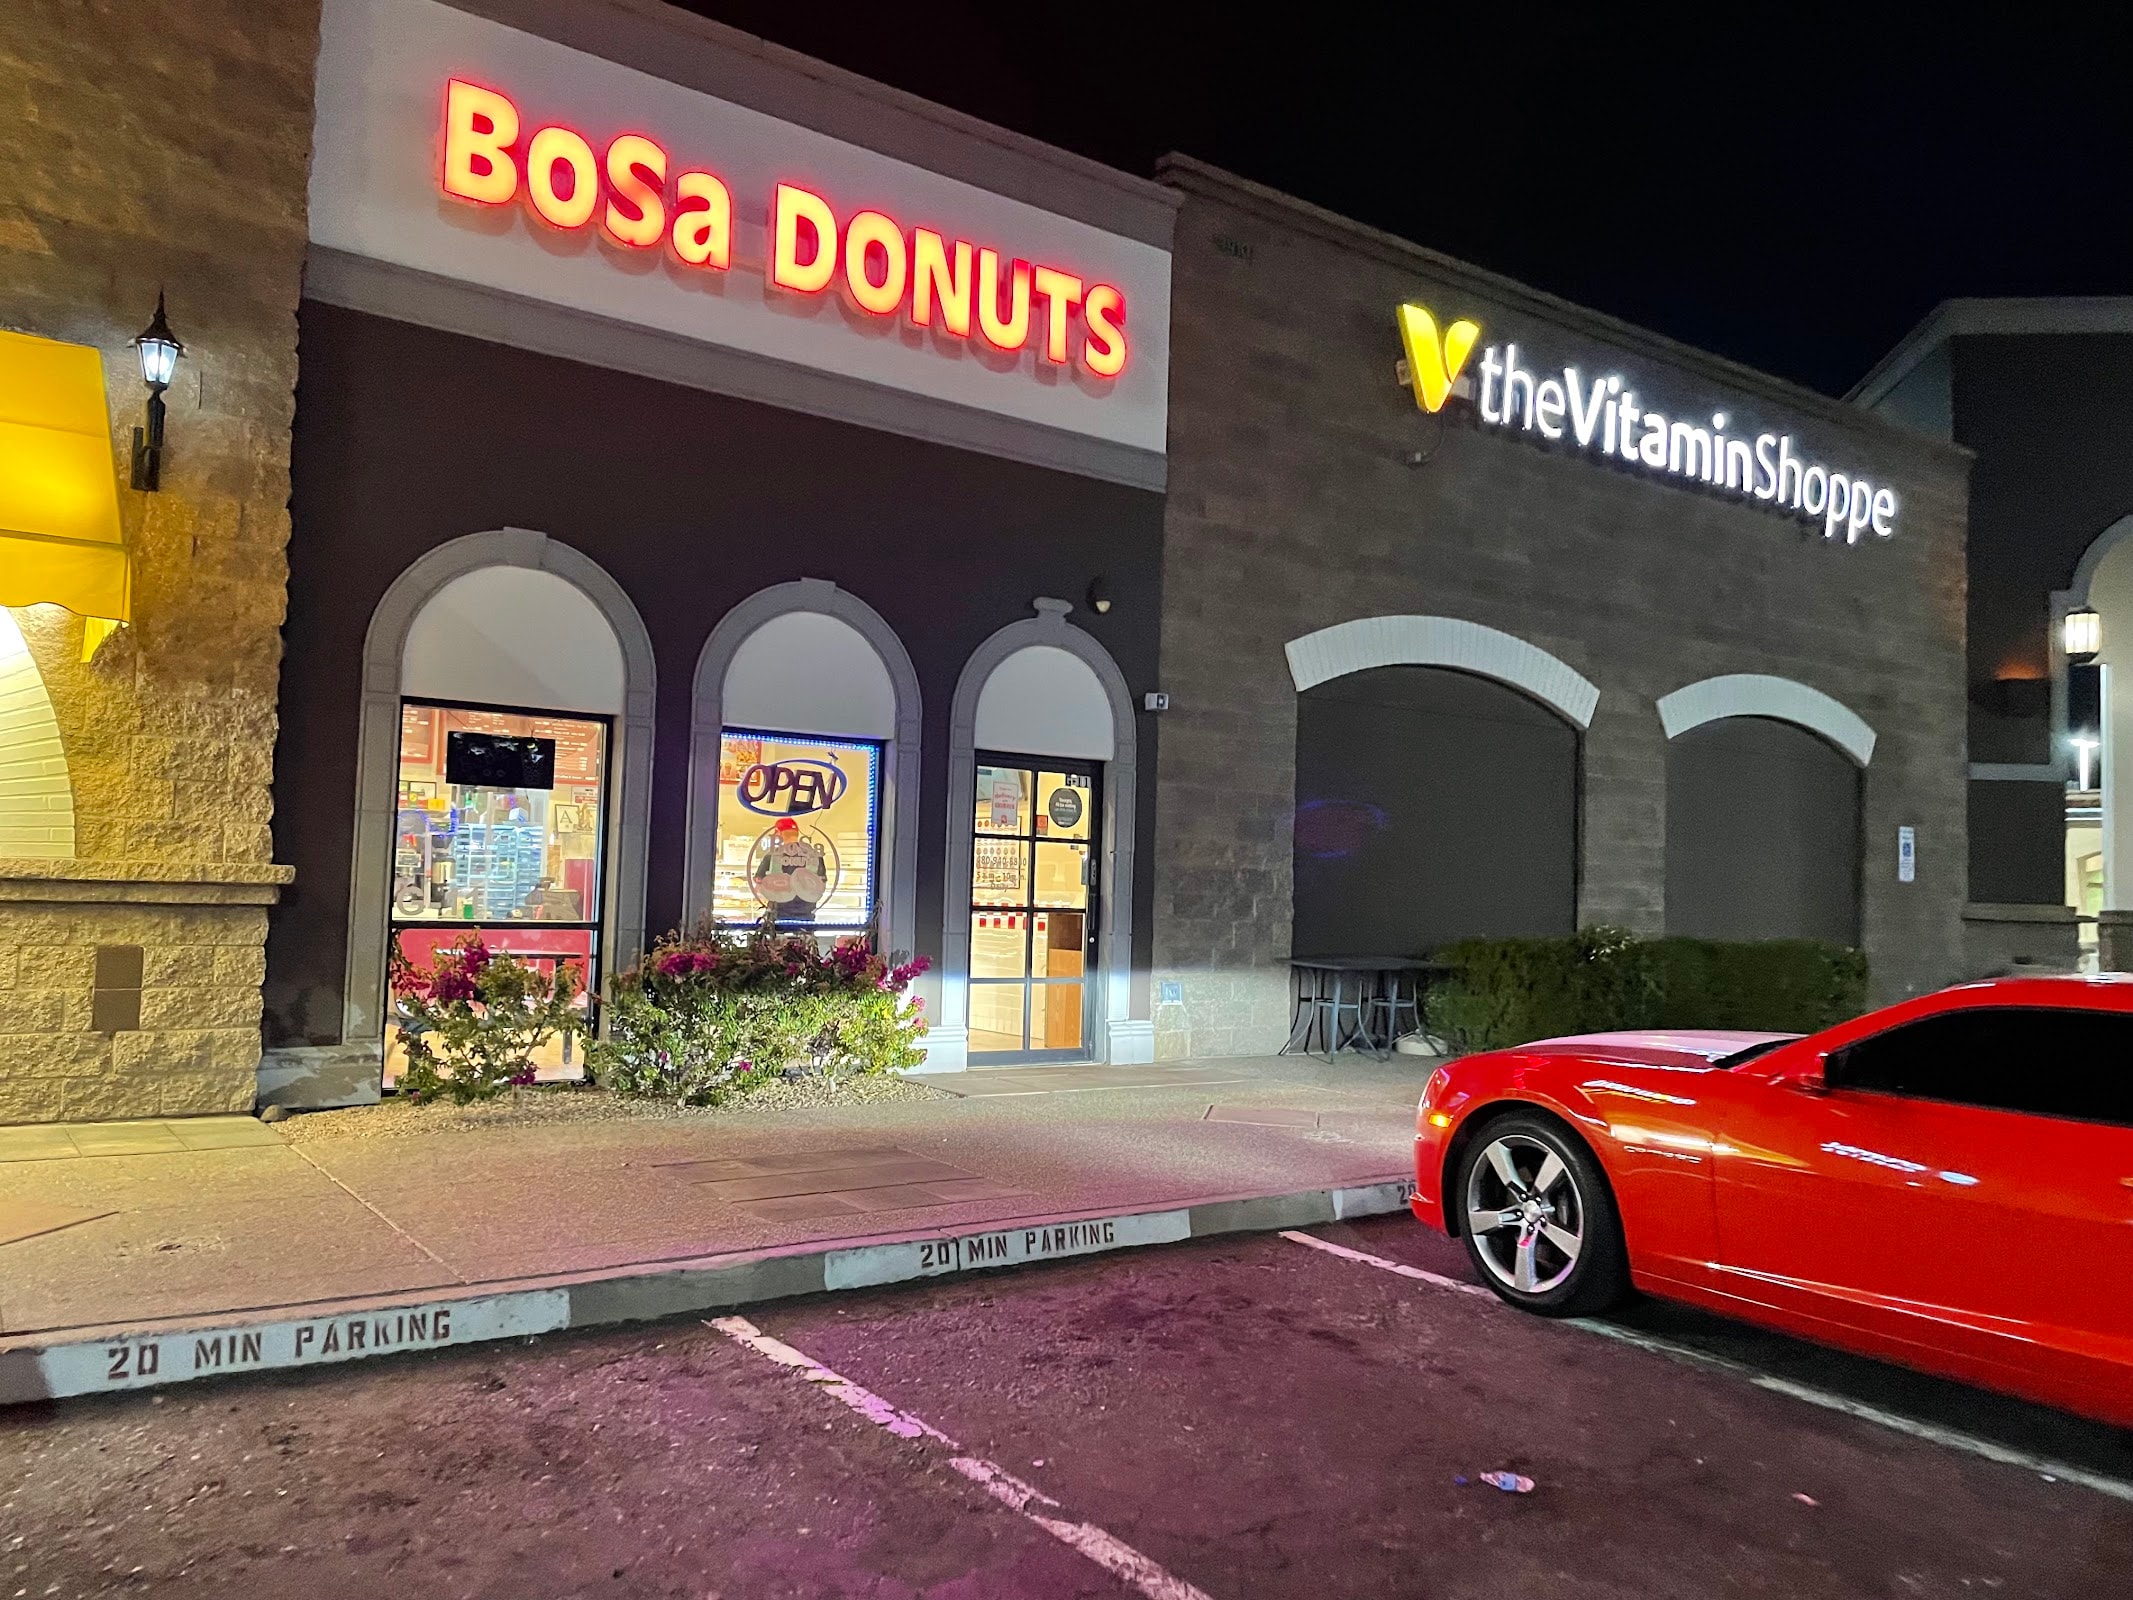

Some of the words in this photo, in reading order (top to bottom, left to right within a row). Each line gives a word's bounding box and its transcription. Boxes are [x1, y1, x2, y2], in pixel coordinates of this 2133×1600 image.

[773, 182, 1128, 377] DONUTS
[743, 764, 838, 812] OPEN
[920, 1243, 951, 1269] 20
[967, 1236, 1008, 1264] MIN
[1025, 1221, 1115, 1255] PARKING
[108, 1343, 160, 1380] 20
[194, 1331, 262, 1370] MIN
[294, 1309, 453, 1358] PARKING
